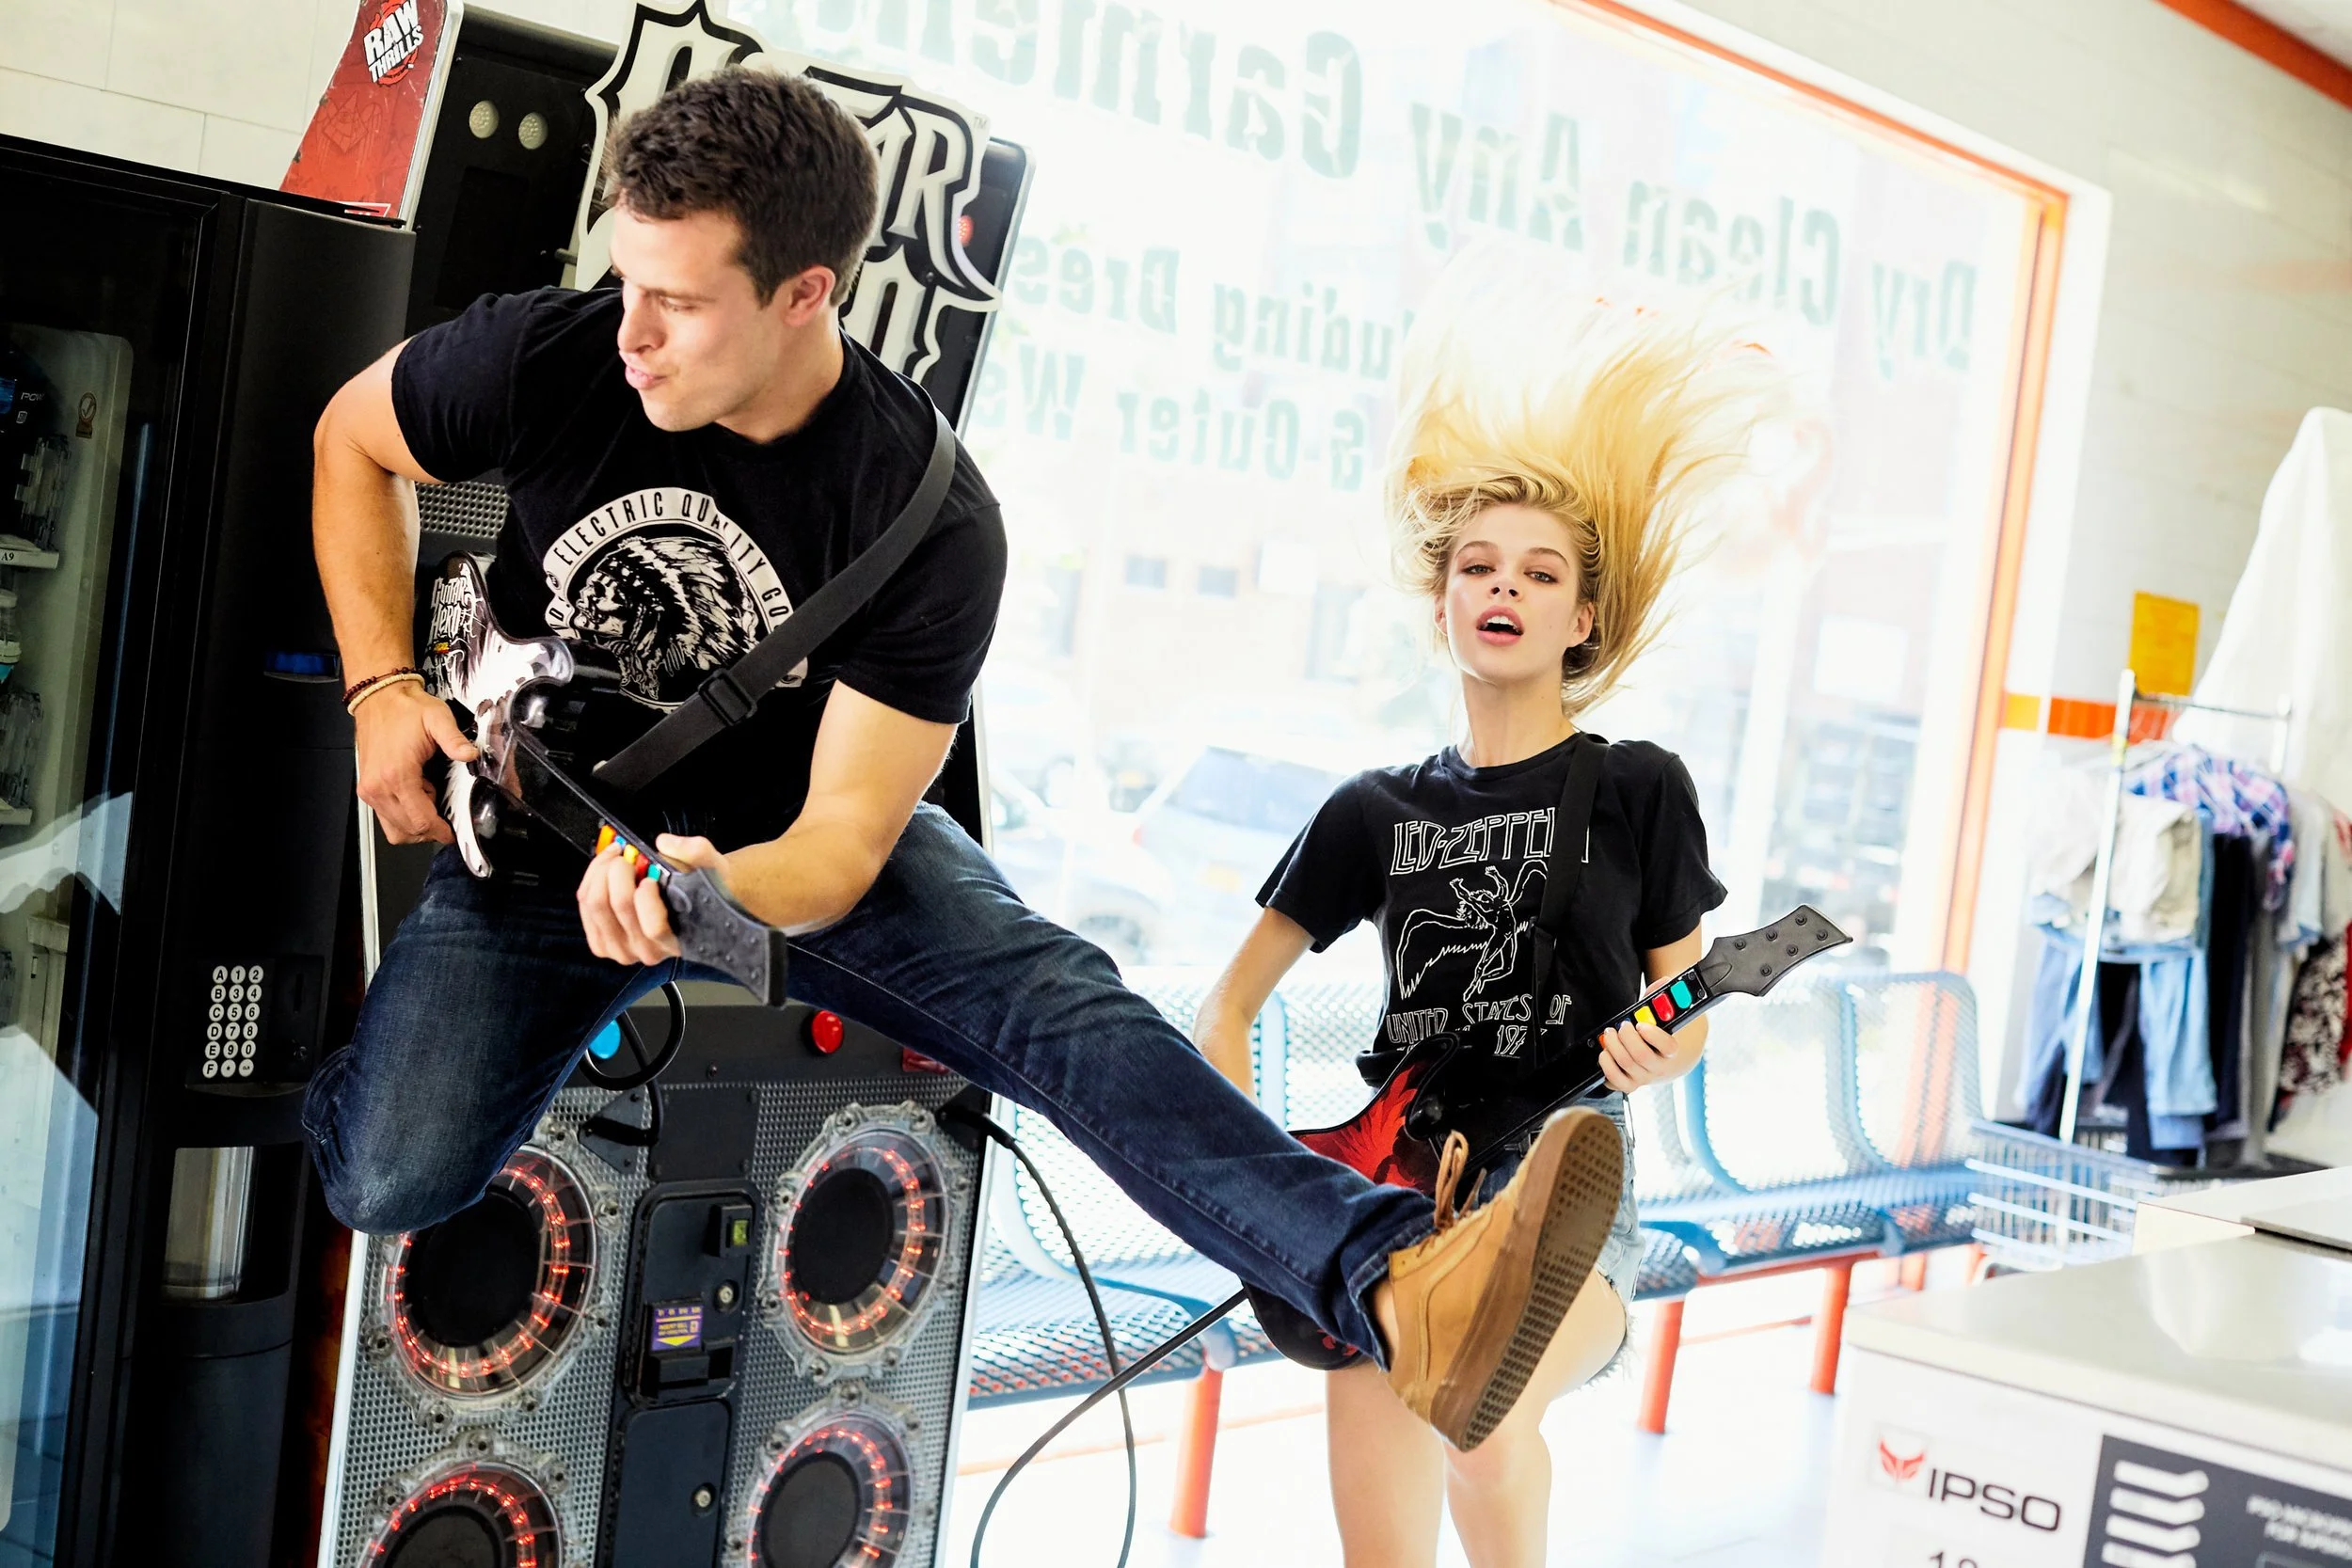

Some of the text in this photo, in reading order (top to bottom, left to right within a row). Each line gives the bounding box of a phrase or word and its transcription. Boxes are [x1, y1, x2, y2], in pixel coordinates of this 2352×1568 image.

[363, 0, 419, 67] RAW
[368, 24, 424, 83] THRILLS
[553, 491, 663, 566] ELECTRIC
[1389, 806, 1589, 876] LED-ZEPPEL
[1545, 993, 1573, 1025] OF
[1929, 1467, 2061, 1532] IPSO
